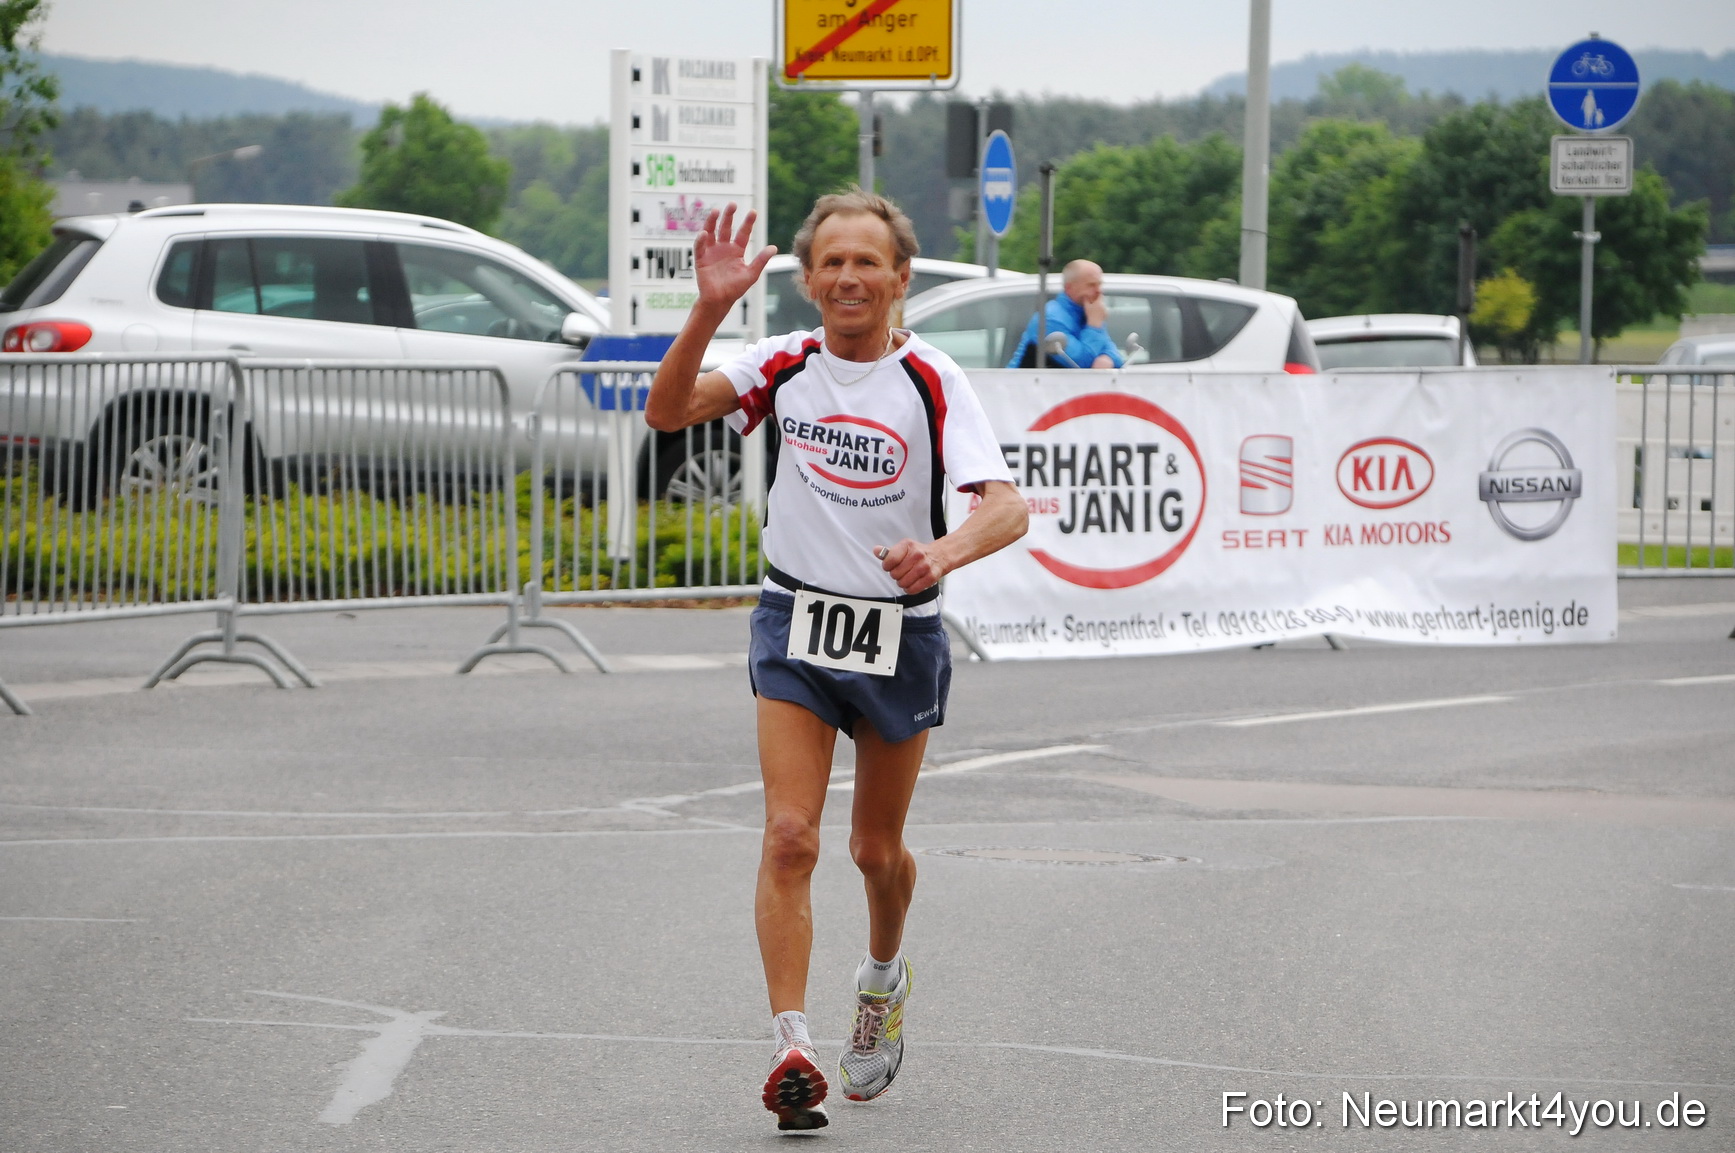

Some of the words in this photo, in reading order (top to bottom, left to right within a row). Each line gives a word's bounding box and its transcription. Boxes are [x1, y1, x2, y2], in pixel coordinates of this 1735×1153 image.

[817, 13, 847, 28] am
[857, 9, 918, 33] Anger
[831, 46, 893, 62] Neumarkt
[782, 416, 885, 454] GERHART
[886, 445, 895, 455] &
[826, 449, 896, 475] JÄNIG
[1000, 443, 1159, 487] ERHART
[1165, 453, 1179, 475] &
[1352, 454, 1417, 492] KIA
[1489, 476, 1573, 494] NISSAN
[1058, 488, 1184, 534] JÄNIG
[1222, 529, 1309, 549] SEAT
[1323, 526, 1354, 546] KIA
[1360, 521, 1452, 545] MOTORS
[807, 599, 882, 665] 104
[965, 615, 1048, 645] Neumarkt
[1063, 612, 1166, 647] Sengenthal
[1181, 611, 1217, 638] Tel.
[1365, 600, 1590, 636] www.gerhart-jaenig.de
